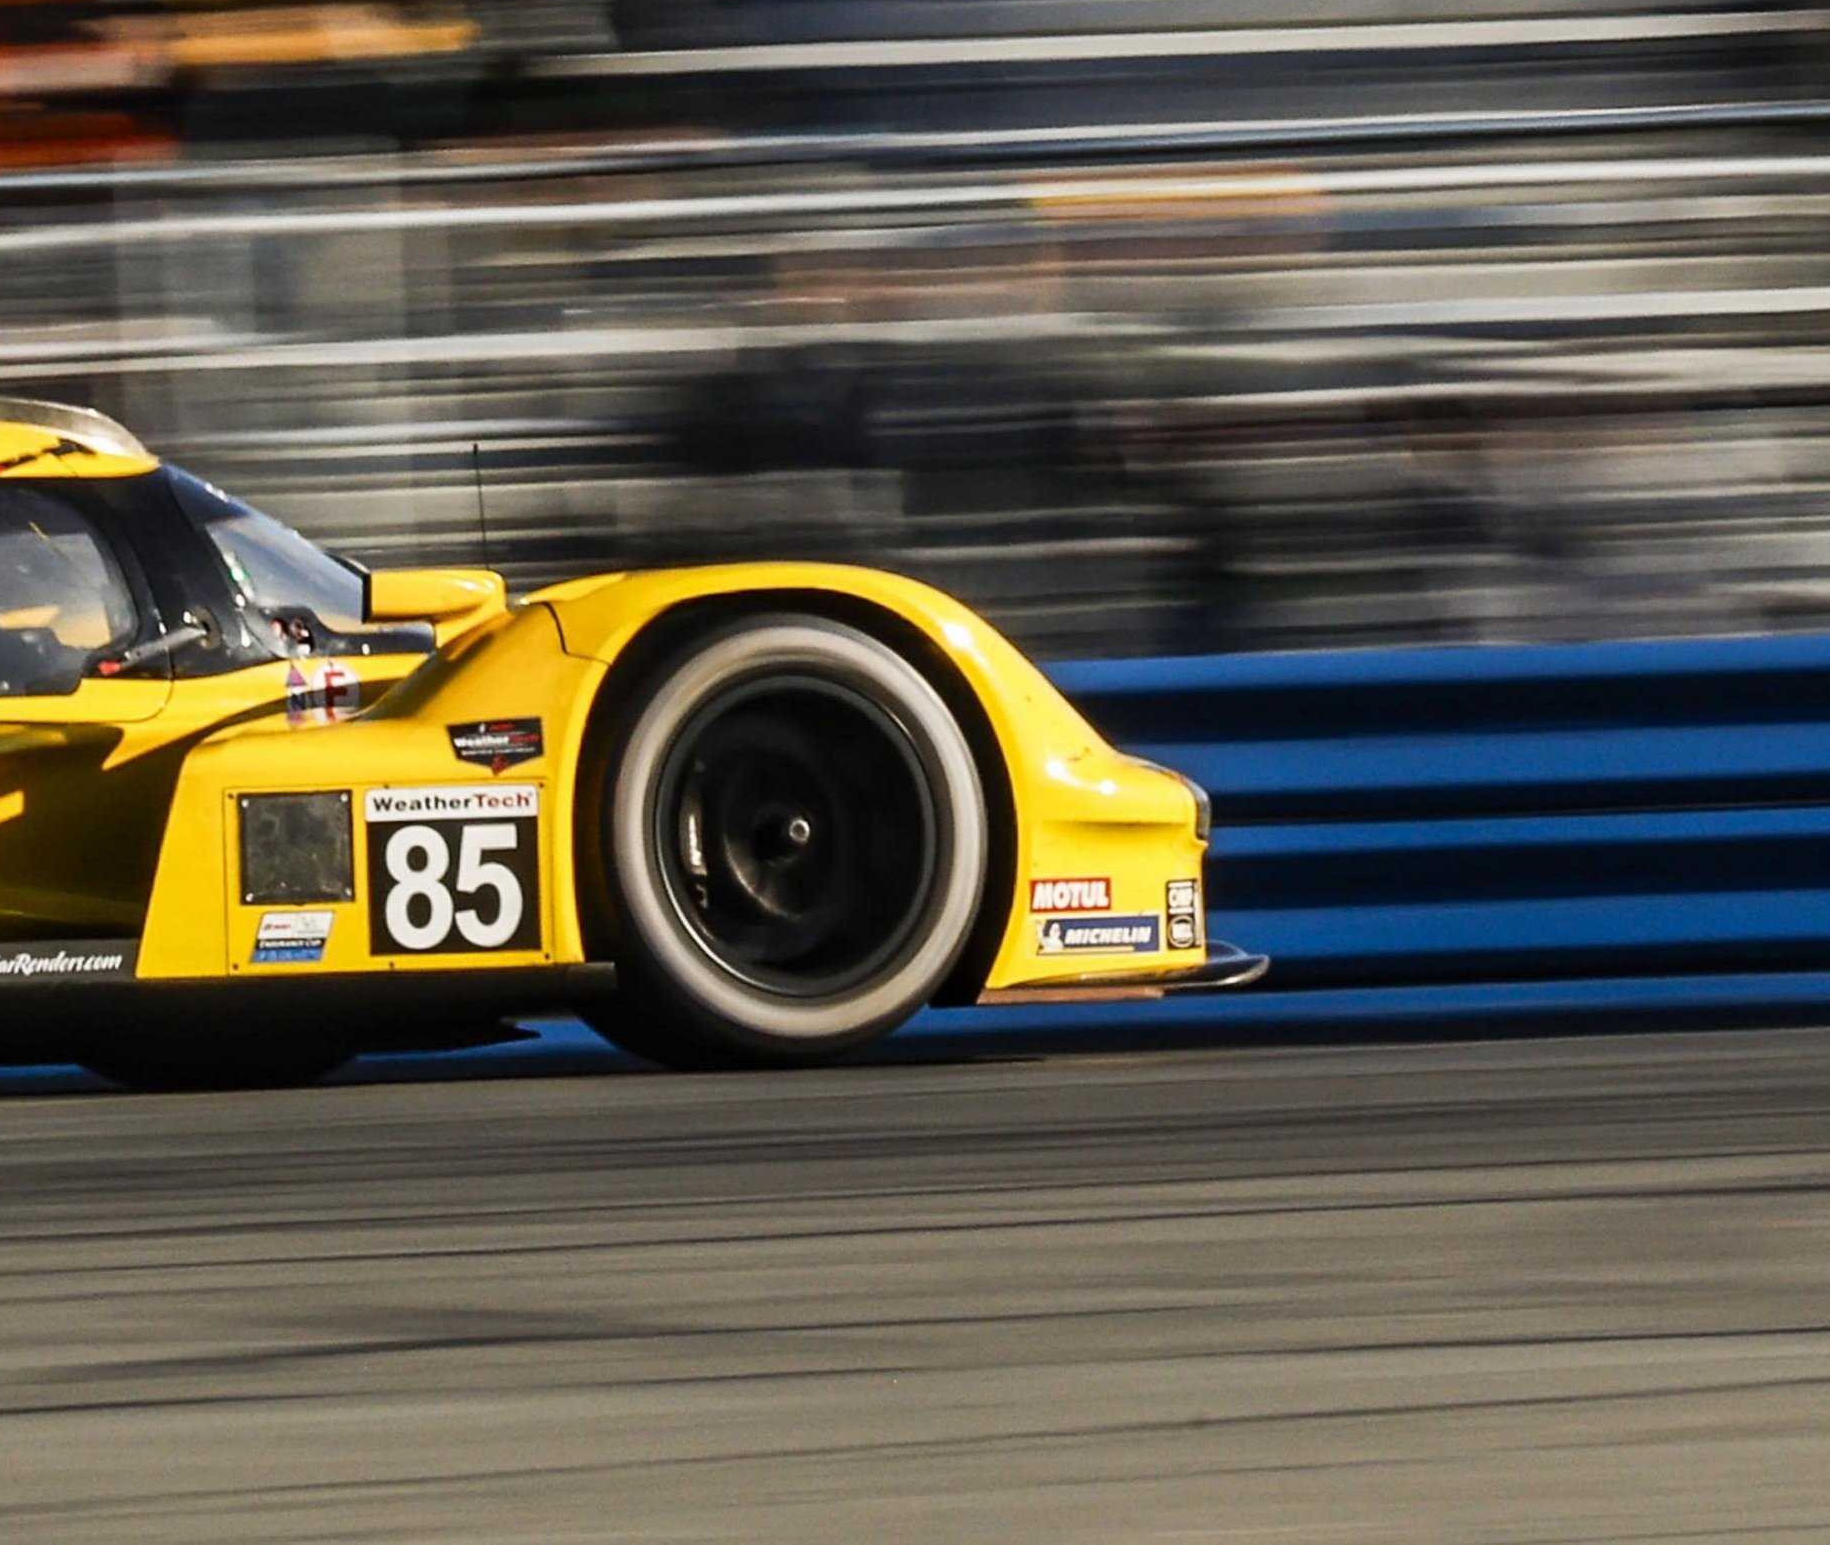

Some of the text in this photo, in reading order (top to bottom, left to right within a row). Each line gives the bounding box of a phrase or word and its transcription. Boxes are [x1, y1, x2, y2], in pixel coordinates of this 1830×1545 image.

[373, 792, 531, 812] WeatherTech
[386, 823, 523, 950] 85
[1032, 881, 1109, 909] MOTUL
[1065, 926, 1152, 945] MICHELIN
